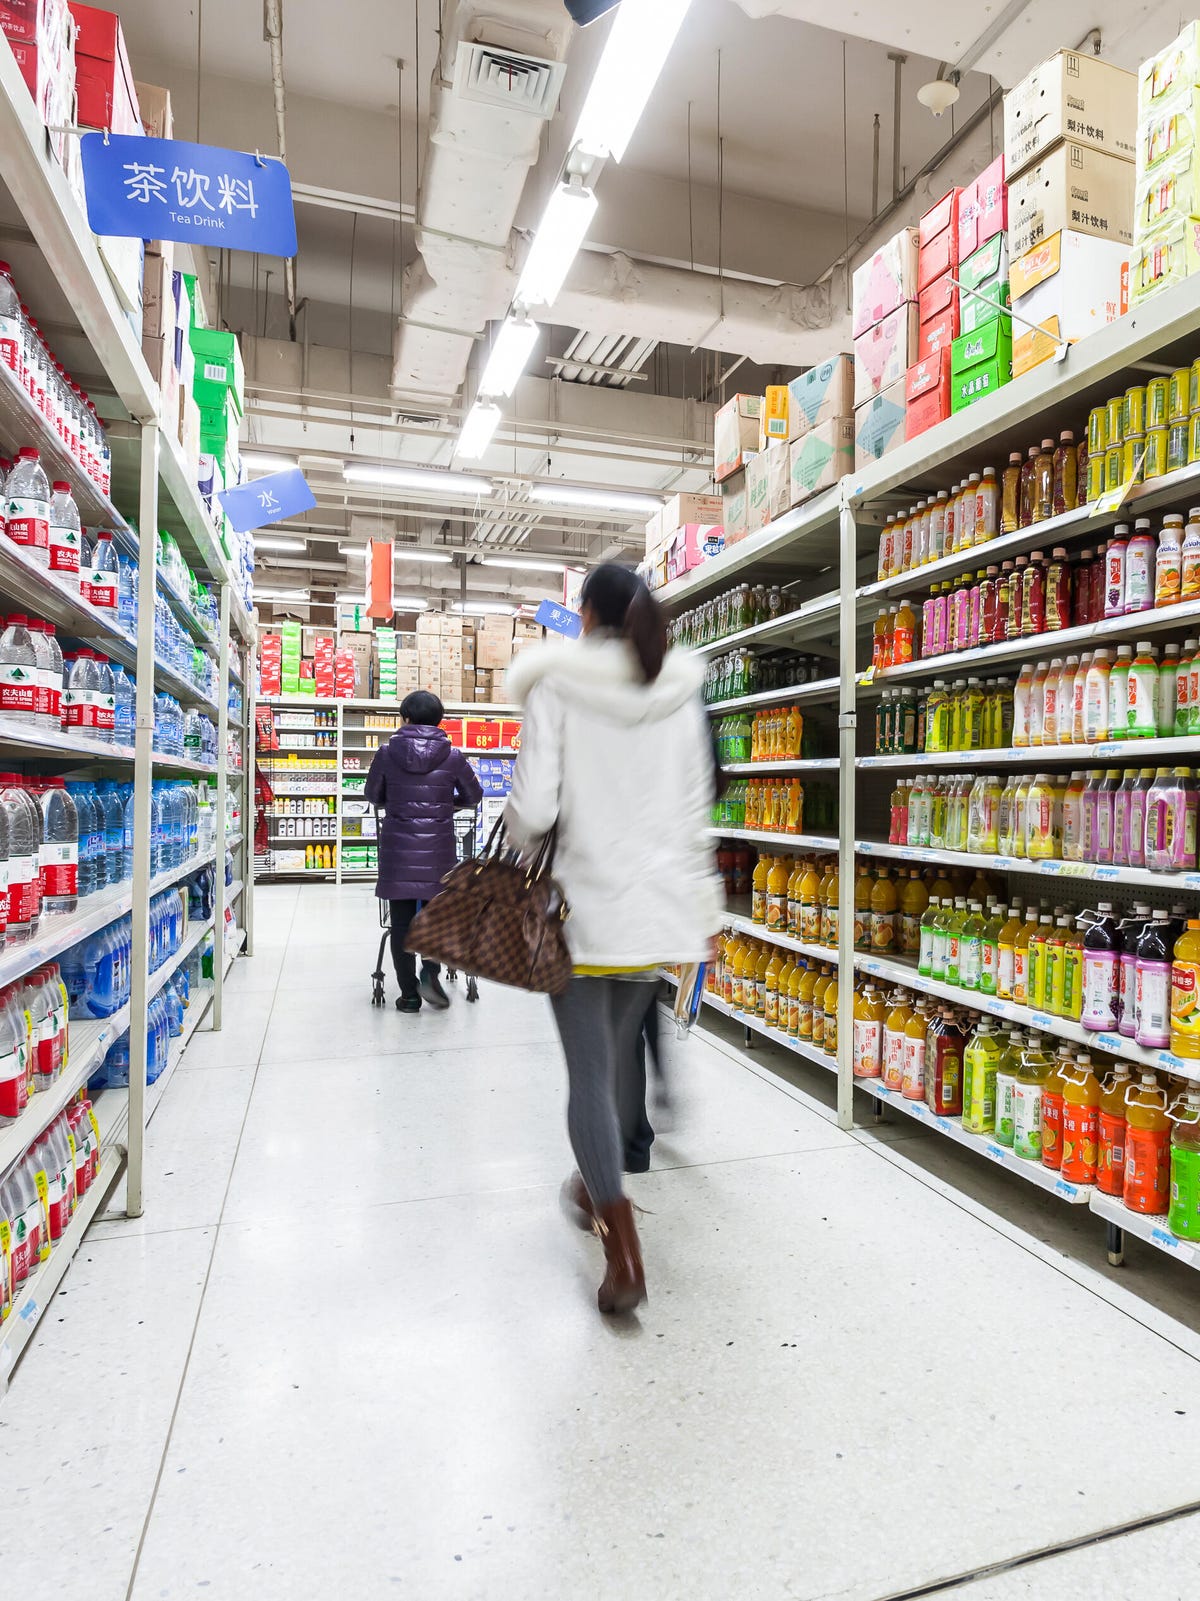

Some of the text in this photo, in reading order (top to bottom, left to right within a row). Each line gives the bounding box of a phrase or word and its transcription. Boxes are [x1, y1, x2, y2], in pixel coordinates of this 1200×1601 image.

[1066, 118, 1104, 141] 梨汁饮料
[122, 161, 259, 219] 茶饮料
[169, 210, 225, 230] Tea Drink
[1071, 209, 1109, 231] 梨汁饮料
[257, 490, 279, 508] 水
[549, 609, 573, 627] 果汁
